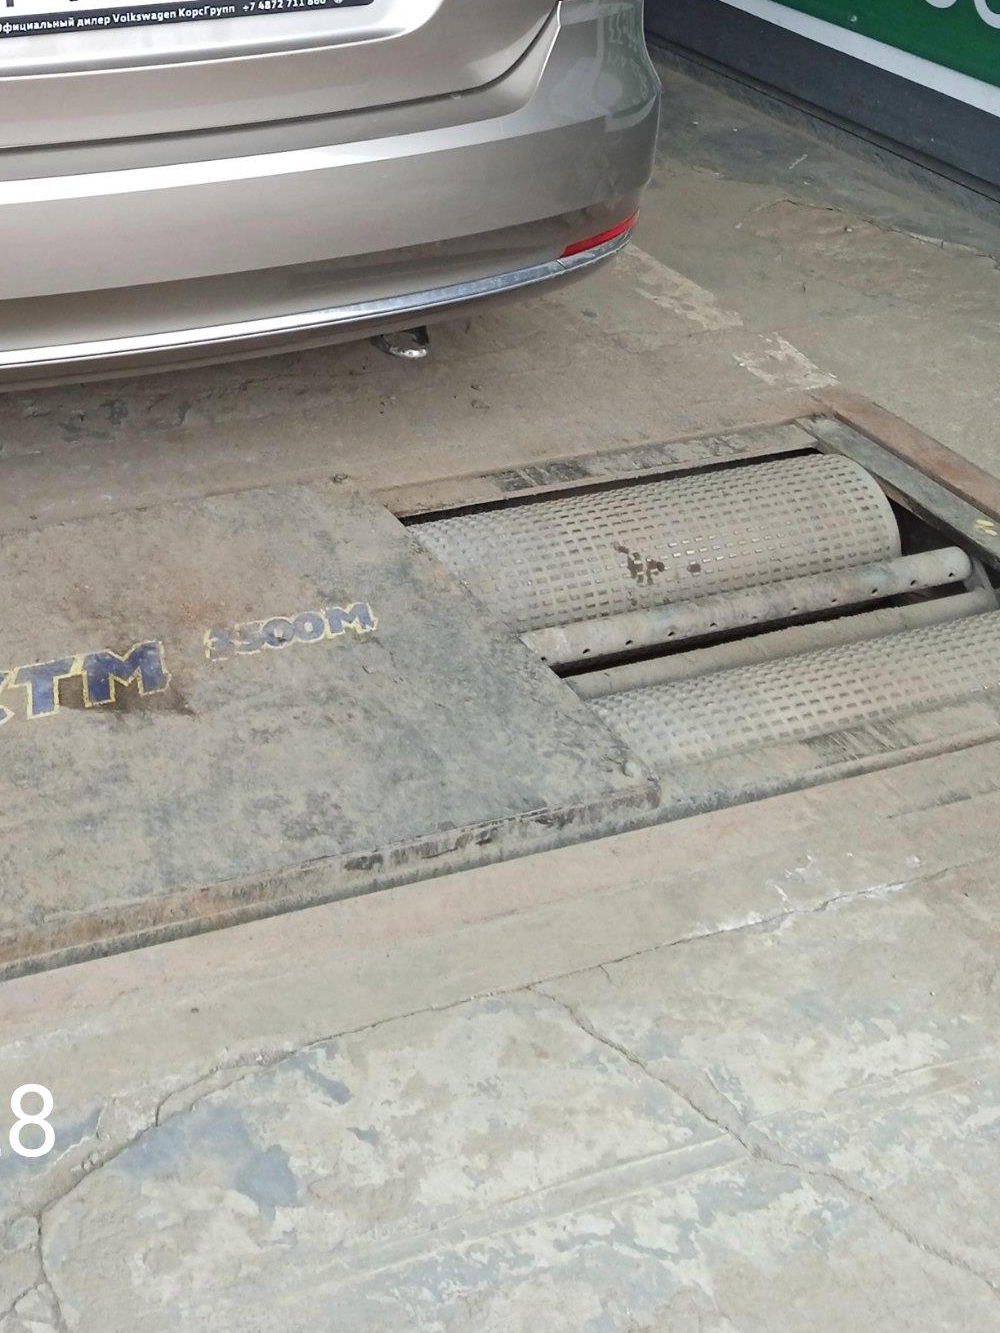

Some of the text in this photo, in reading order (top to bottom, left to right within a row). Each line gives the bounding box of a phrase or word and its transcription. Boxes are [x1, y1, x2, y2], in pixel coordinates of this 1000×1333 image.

[76, 15, 111, 30] дилер
[112, 10, 177, 25] Volkswagen
[178, 4, 235, 19] КорсГрупп
[258, 0, 283, 11] 4872
